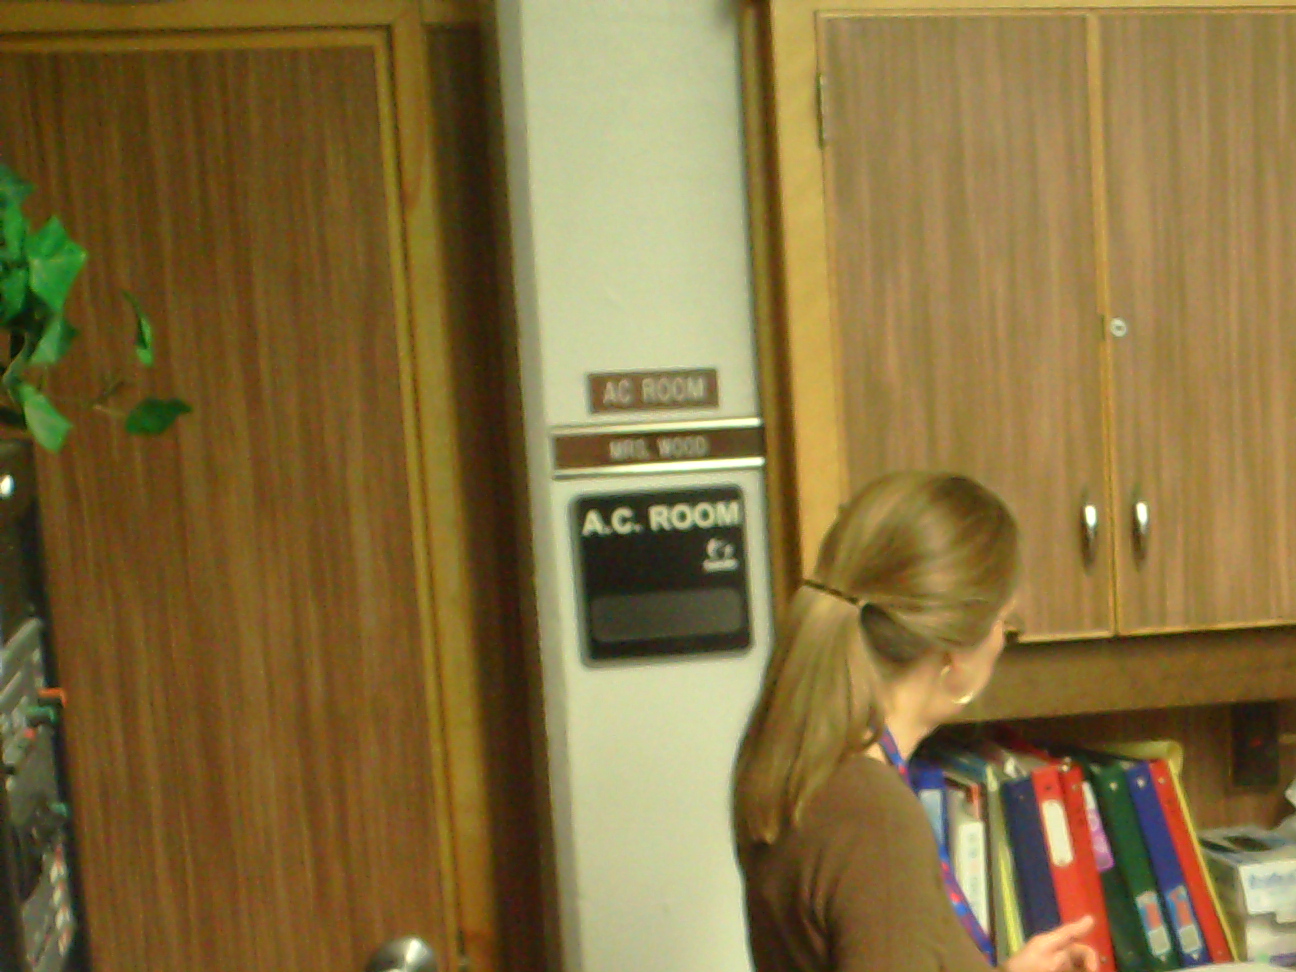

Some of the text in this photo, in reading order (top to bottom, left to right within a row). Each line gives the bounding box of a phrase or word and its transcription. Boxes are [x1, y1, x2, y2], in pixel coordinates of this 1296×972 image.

[603, 376, 706, 404] AC ROOM
[582, 502, 740, 536] A.C. ROOM
